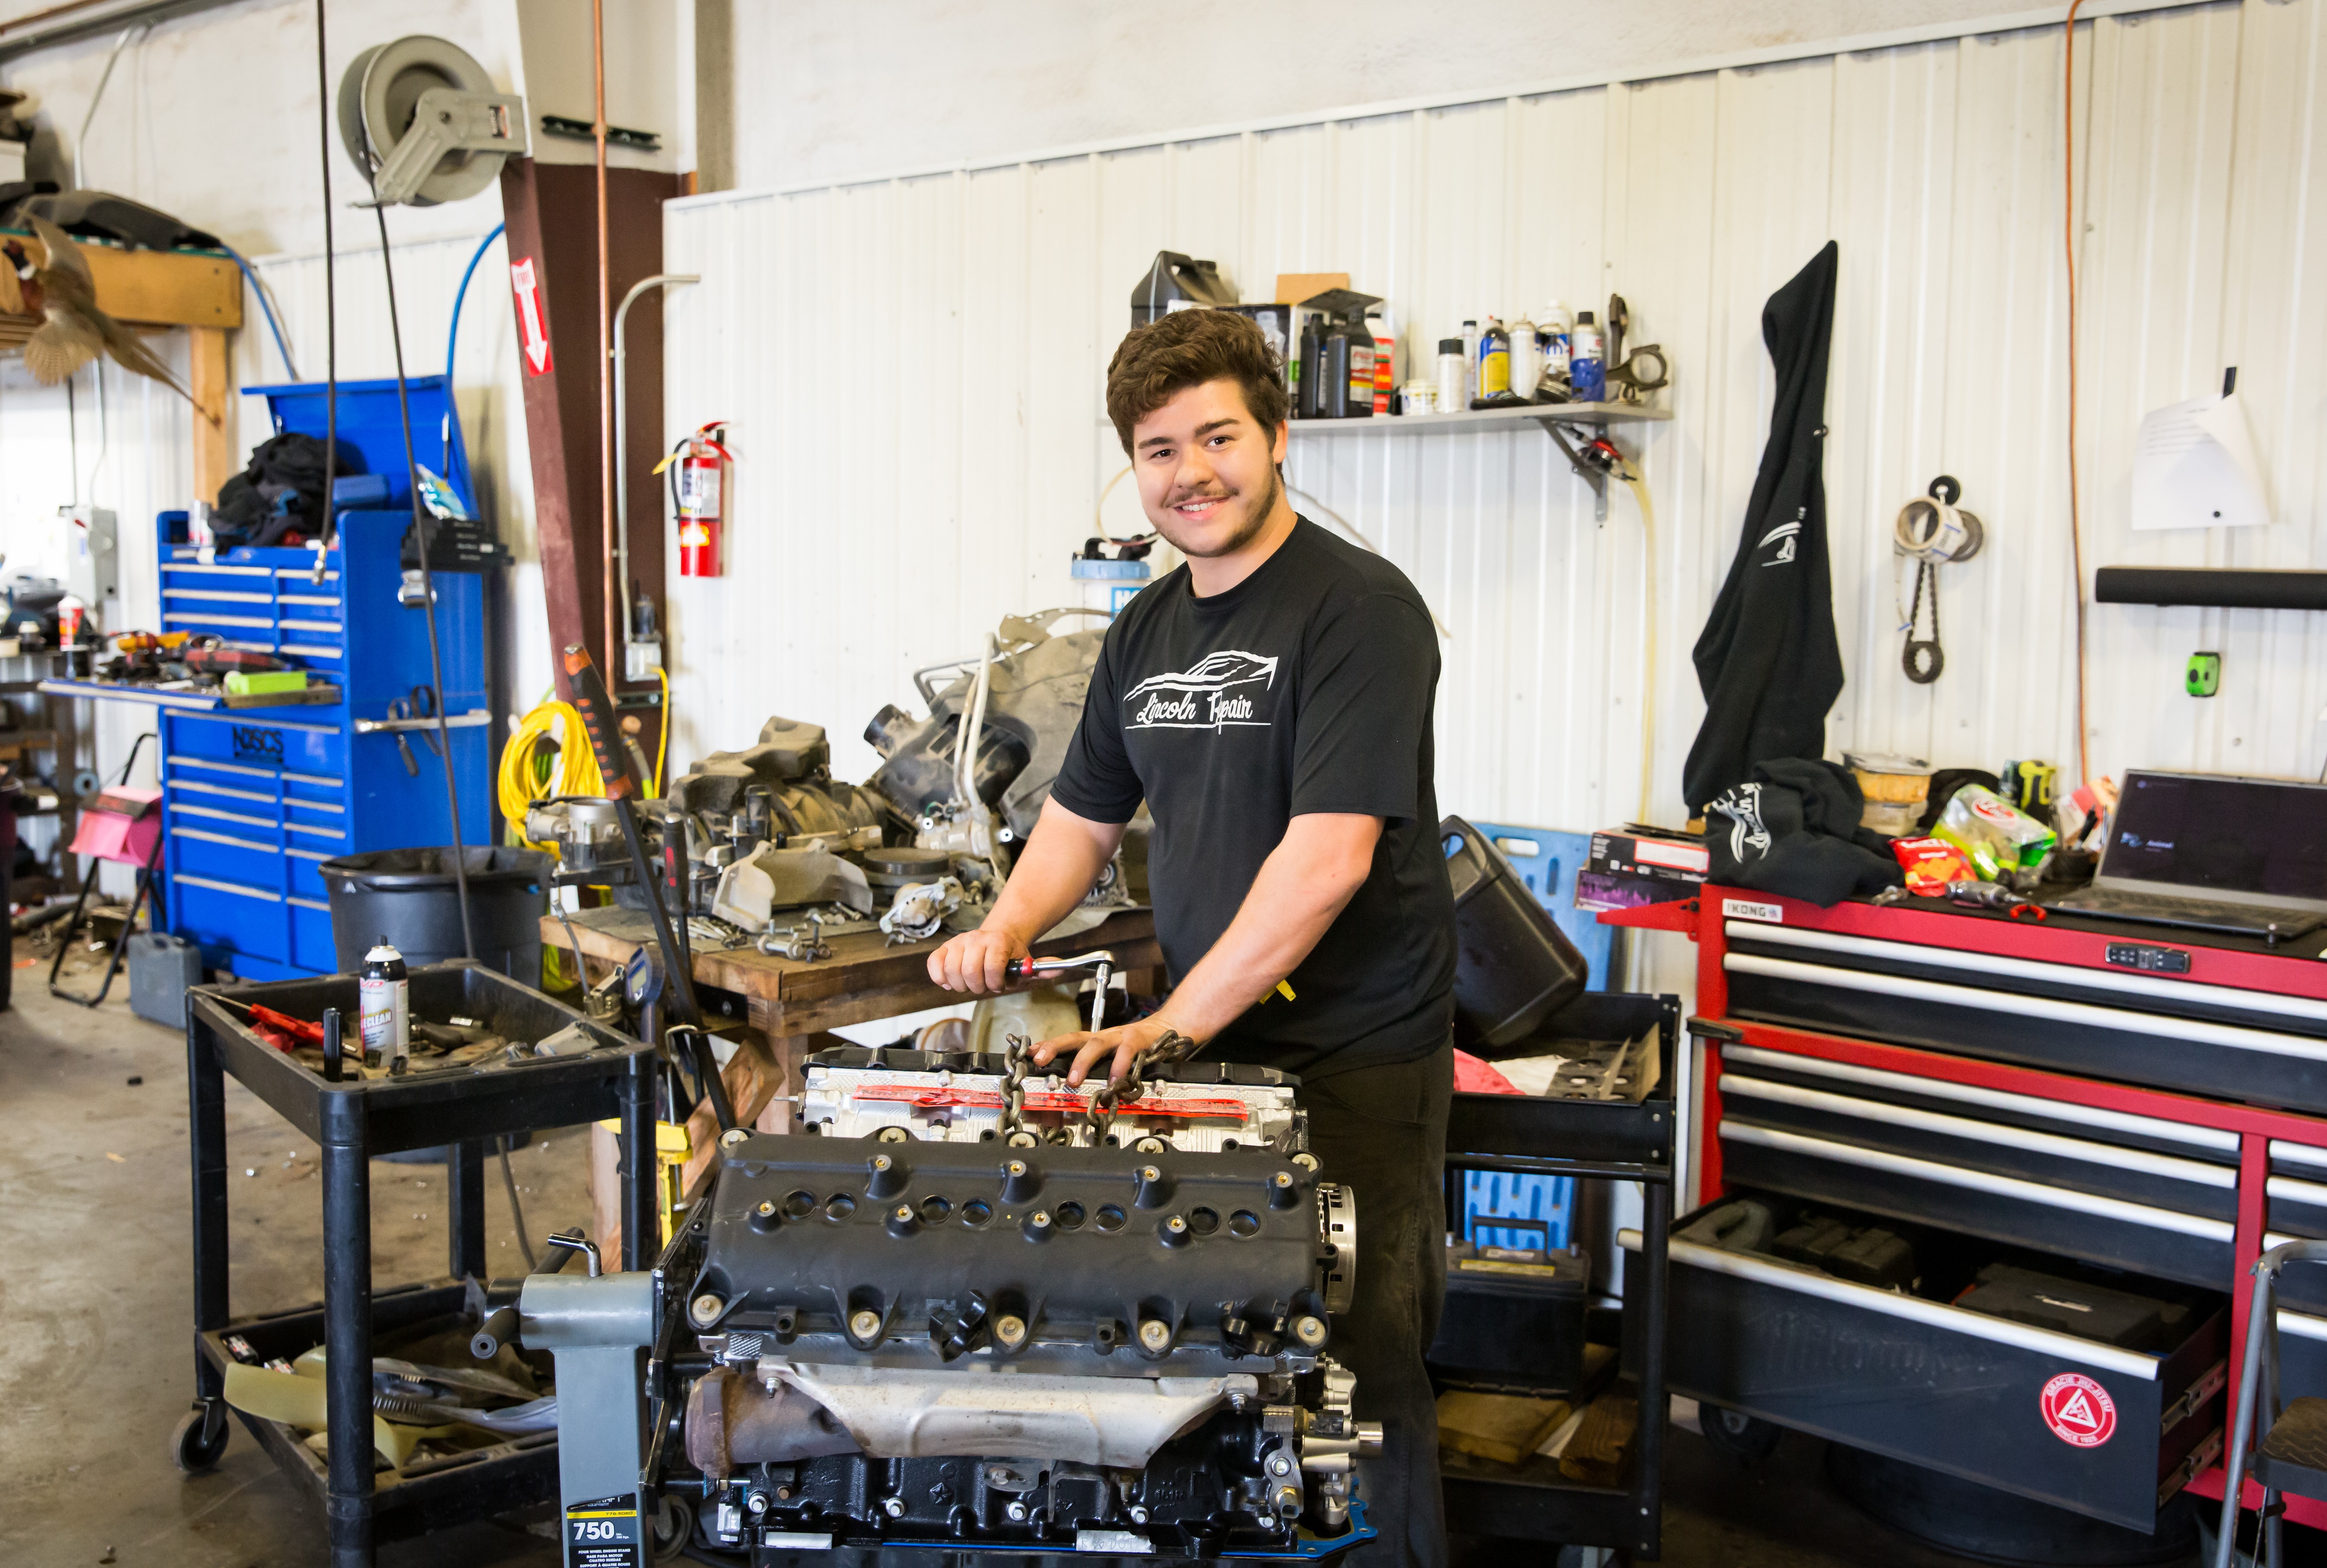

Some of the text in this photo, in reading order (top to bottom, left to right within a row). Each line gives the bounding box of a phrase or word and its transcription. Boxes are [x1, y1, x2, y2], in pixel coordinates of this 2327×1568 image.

[1136, 691, 1196, 725] Lincoln
[1732, 904, 1766, 917] KONG
[573, 1521, 615, 1540] 750
